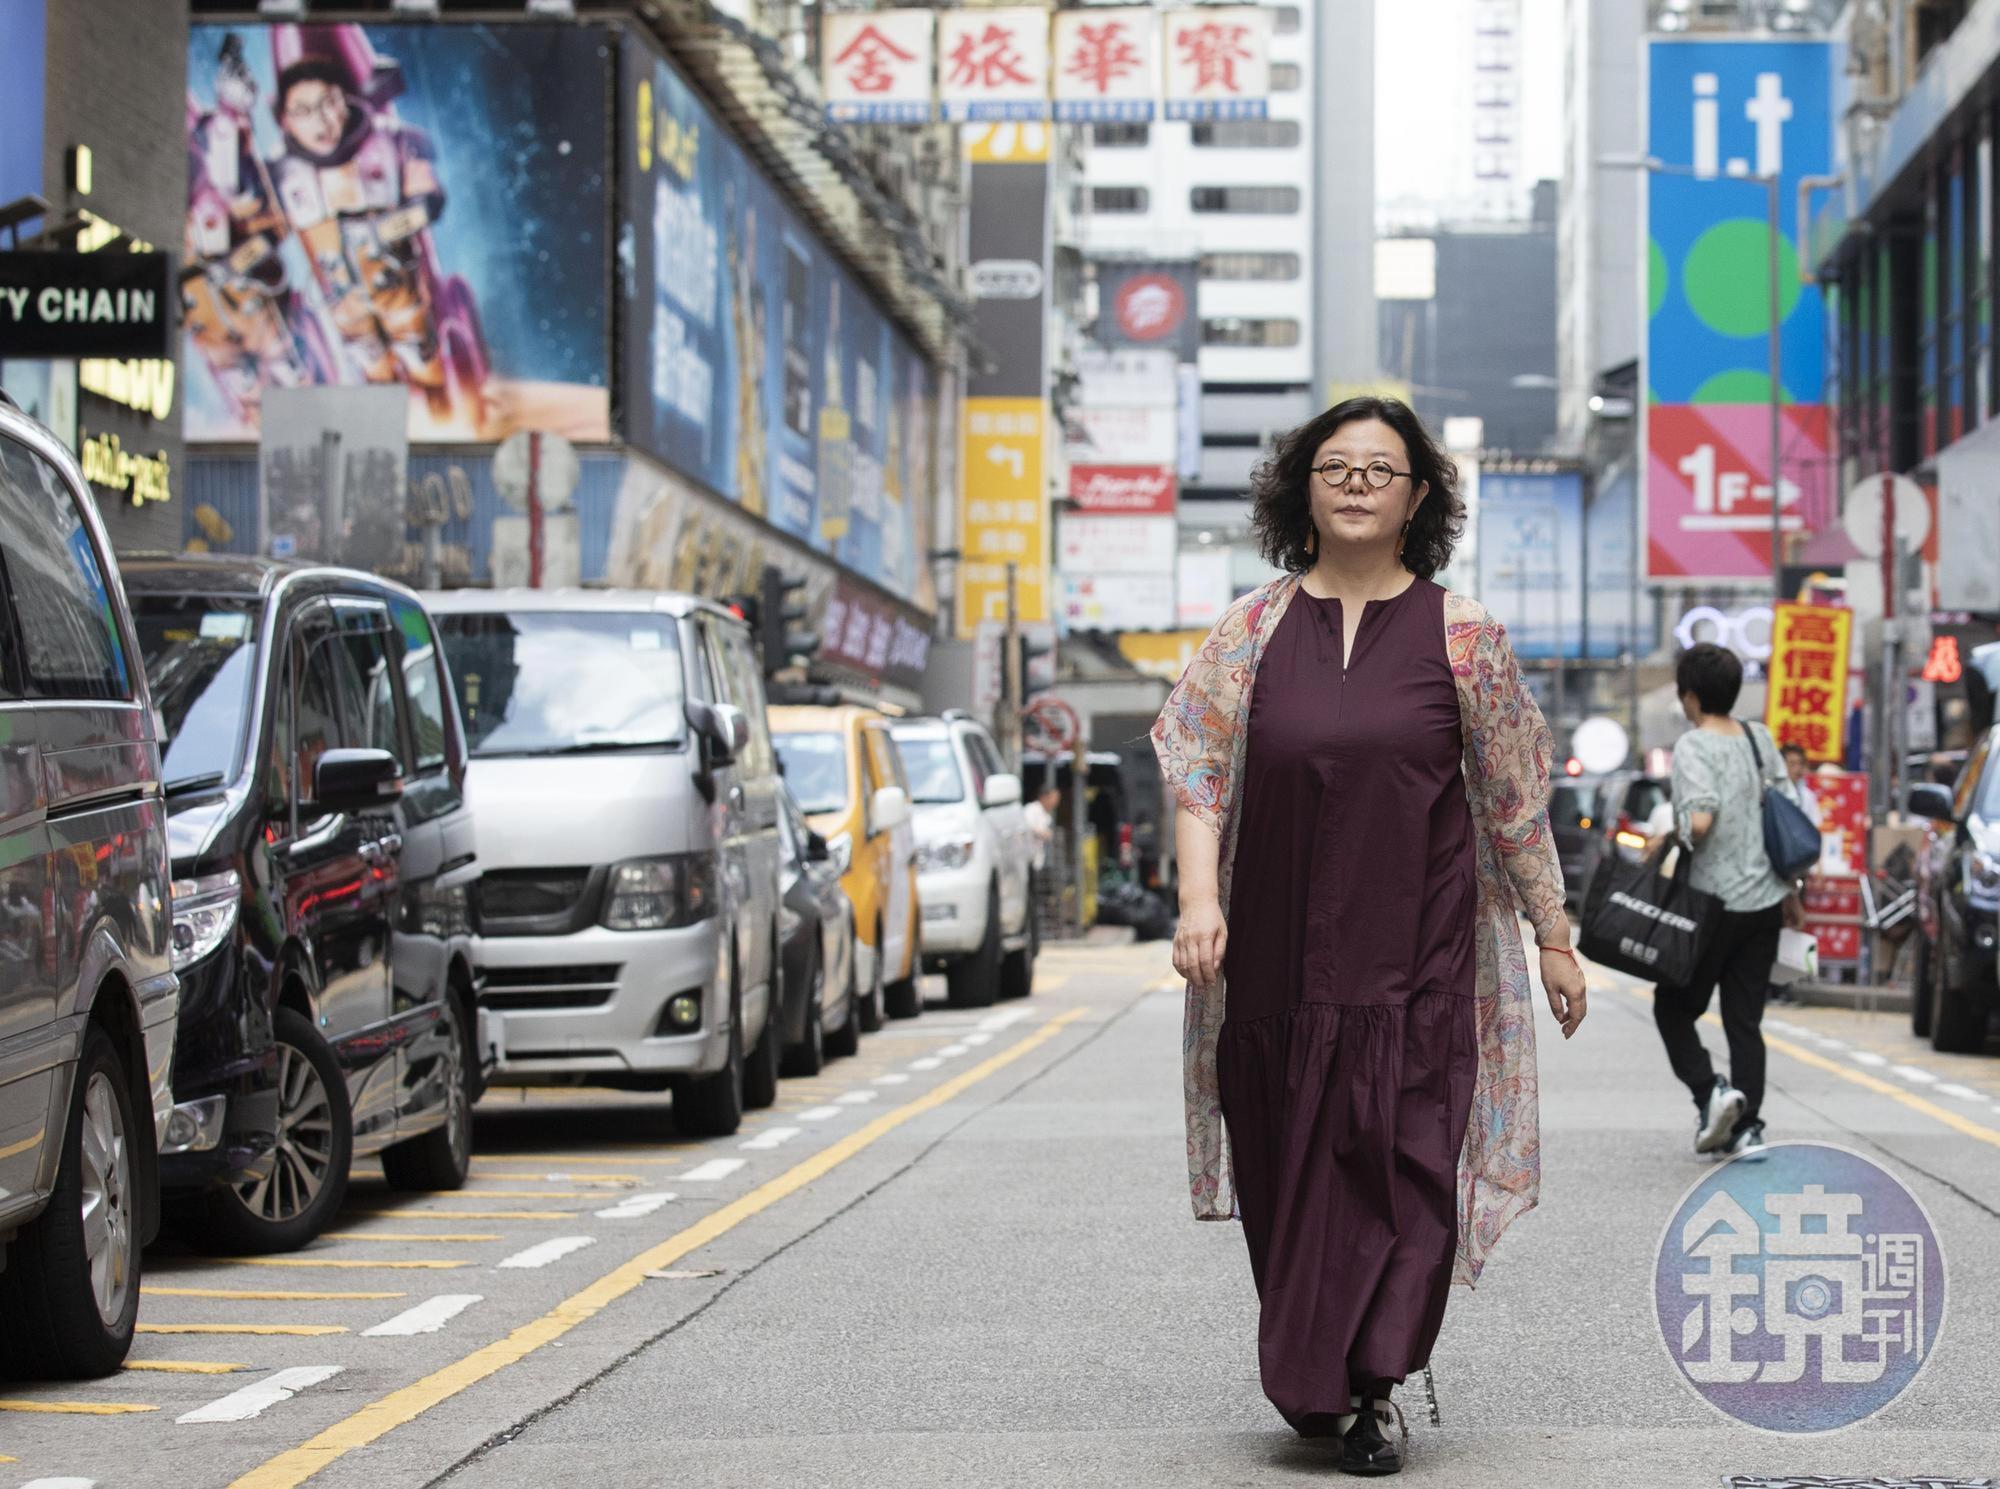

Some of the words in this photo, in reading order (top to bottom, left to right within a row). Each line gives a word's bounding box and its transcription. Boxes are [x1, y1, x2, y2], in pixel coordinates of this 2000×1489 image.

[1692, 73, 1793, 180] i.t
[37, 286, 156, 323] CHAIN
[1678, 444, 1749, 513] 1F
